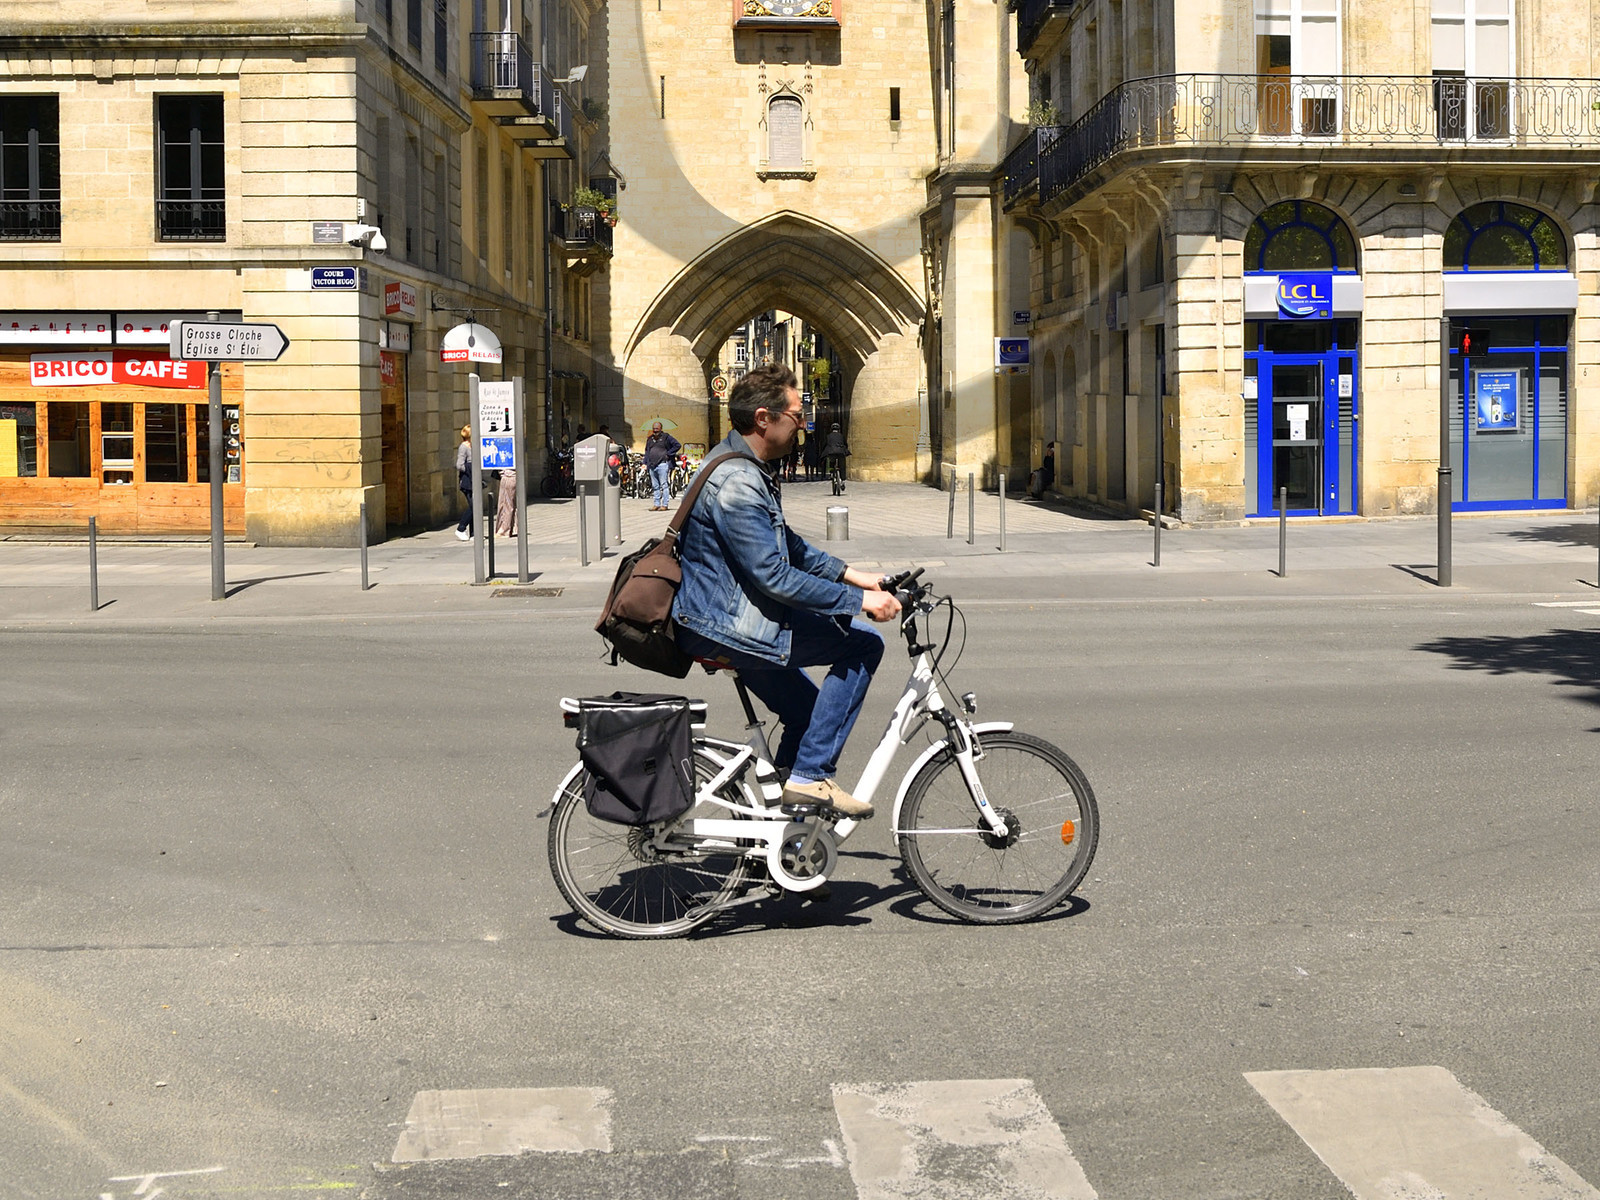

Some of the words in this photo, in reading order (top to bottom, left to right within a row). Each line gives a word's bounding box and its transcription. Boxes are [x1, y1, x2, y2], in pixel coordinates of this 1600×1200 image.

[1280, 284, 1325, 299] LCL
[186, 327, 221, 340] Grosse
[228, 328, 262, 341] Cloche
[186, 341, 219, 357] Église
[226, 344, 236, 355] St
[240, 341, 260, 355] Éloi
[442, 351, 467, 359] BRICO
[472, 351, 501, 359] RELAIS
[1001, 345, 1026, 353] LCL
[33, 359, 108, 378] BRICO
[125, 358, 188, 380] CAFÉ
